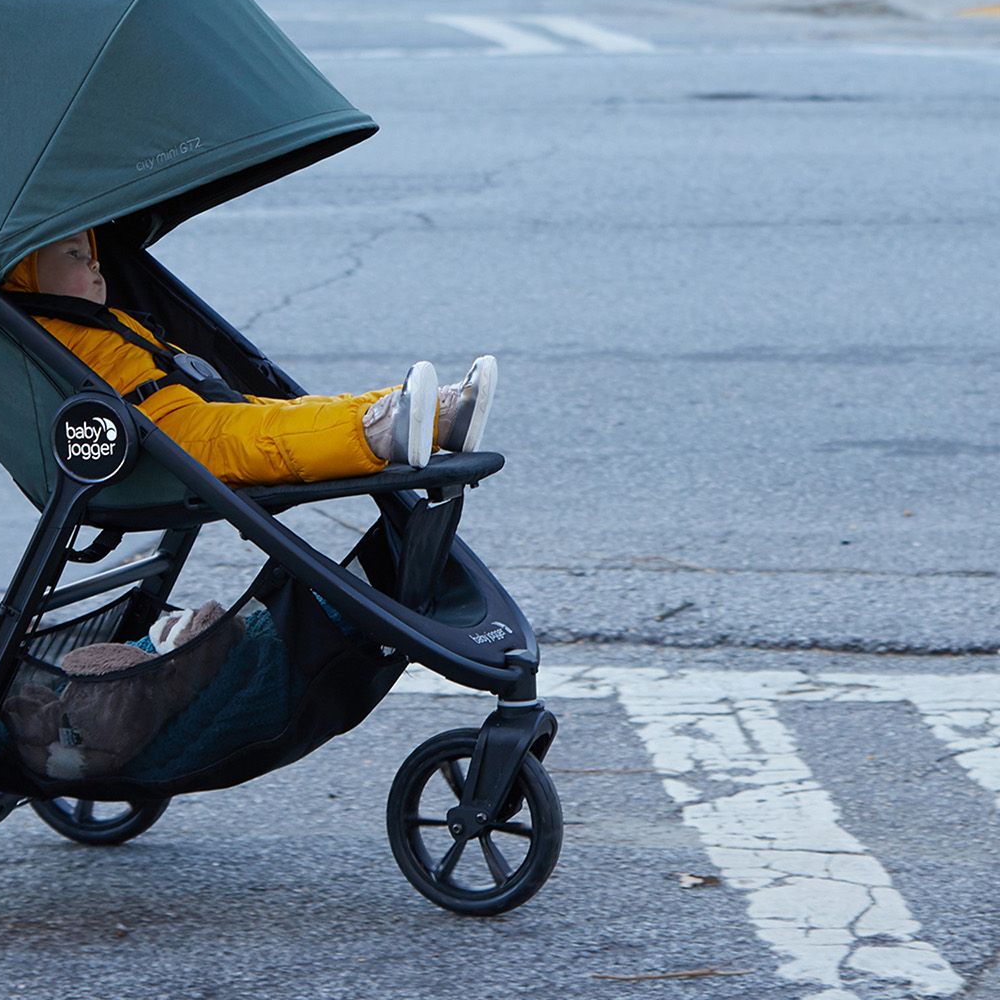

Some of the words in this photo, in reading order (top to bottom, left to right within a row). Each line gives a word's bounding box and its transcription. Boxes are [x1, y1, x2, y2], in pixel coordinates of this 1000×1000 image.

[156, 146, 178, 164] mini
[180, 136, 203, 153] GT2
[65, 421, 102, 443] baby
[67, 440, 116, 460] jogger
